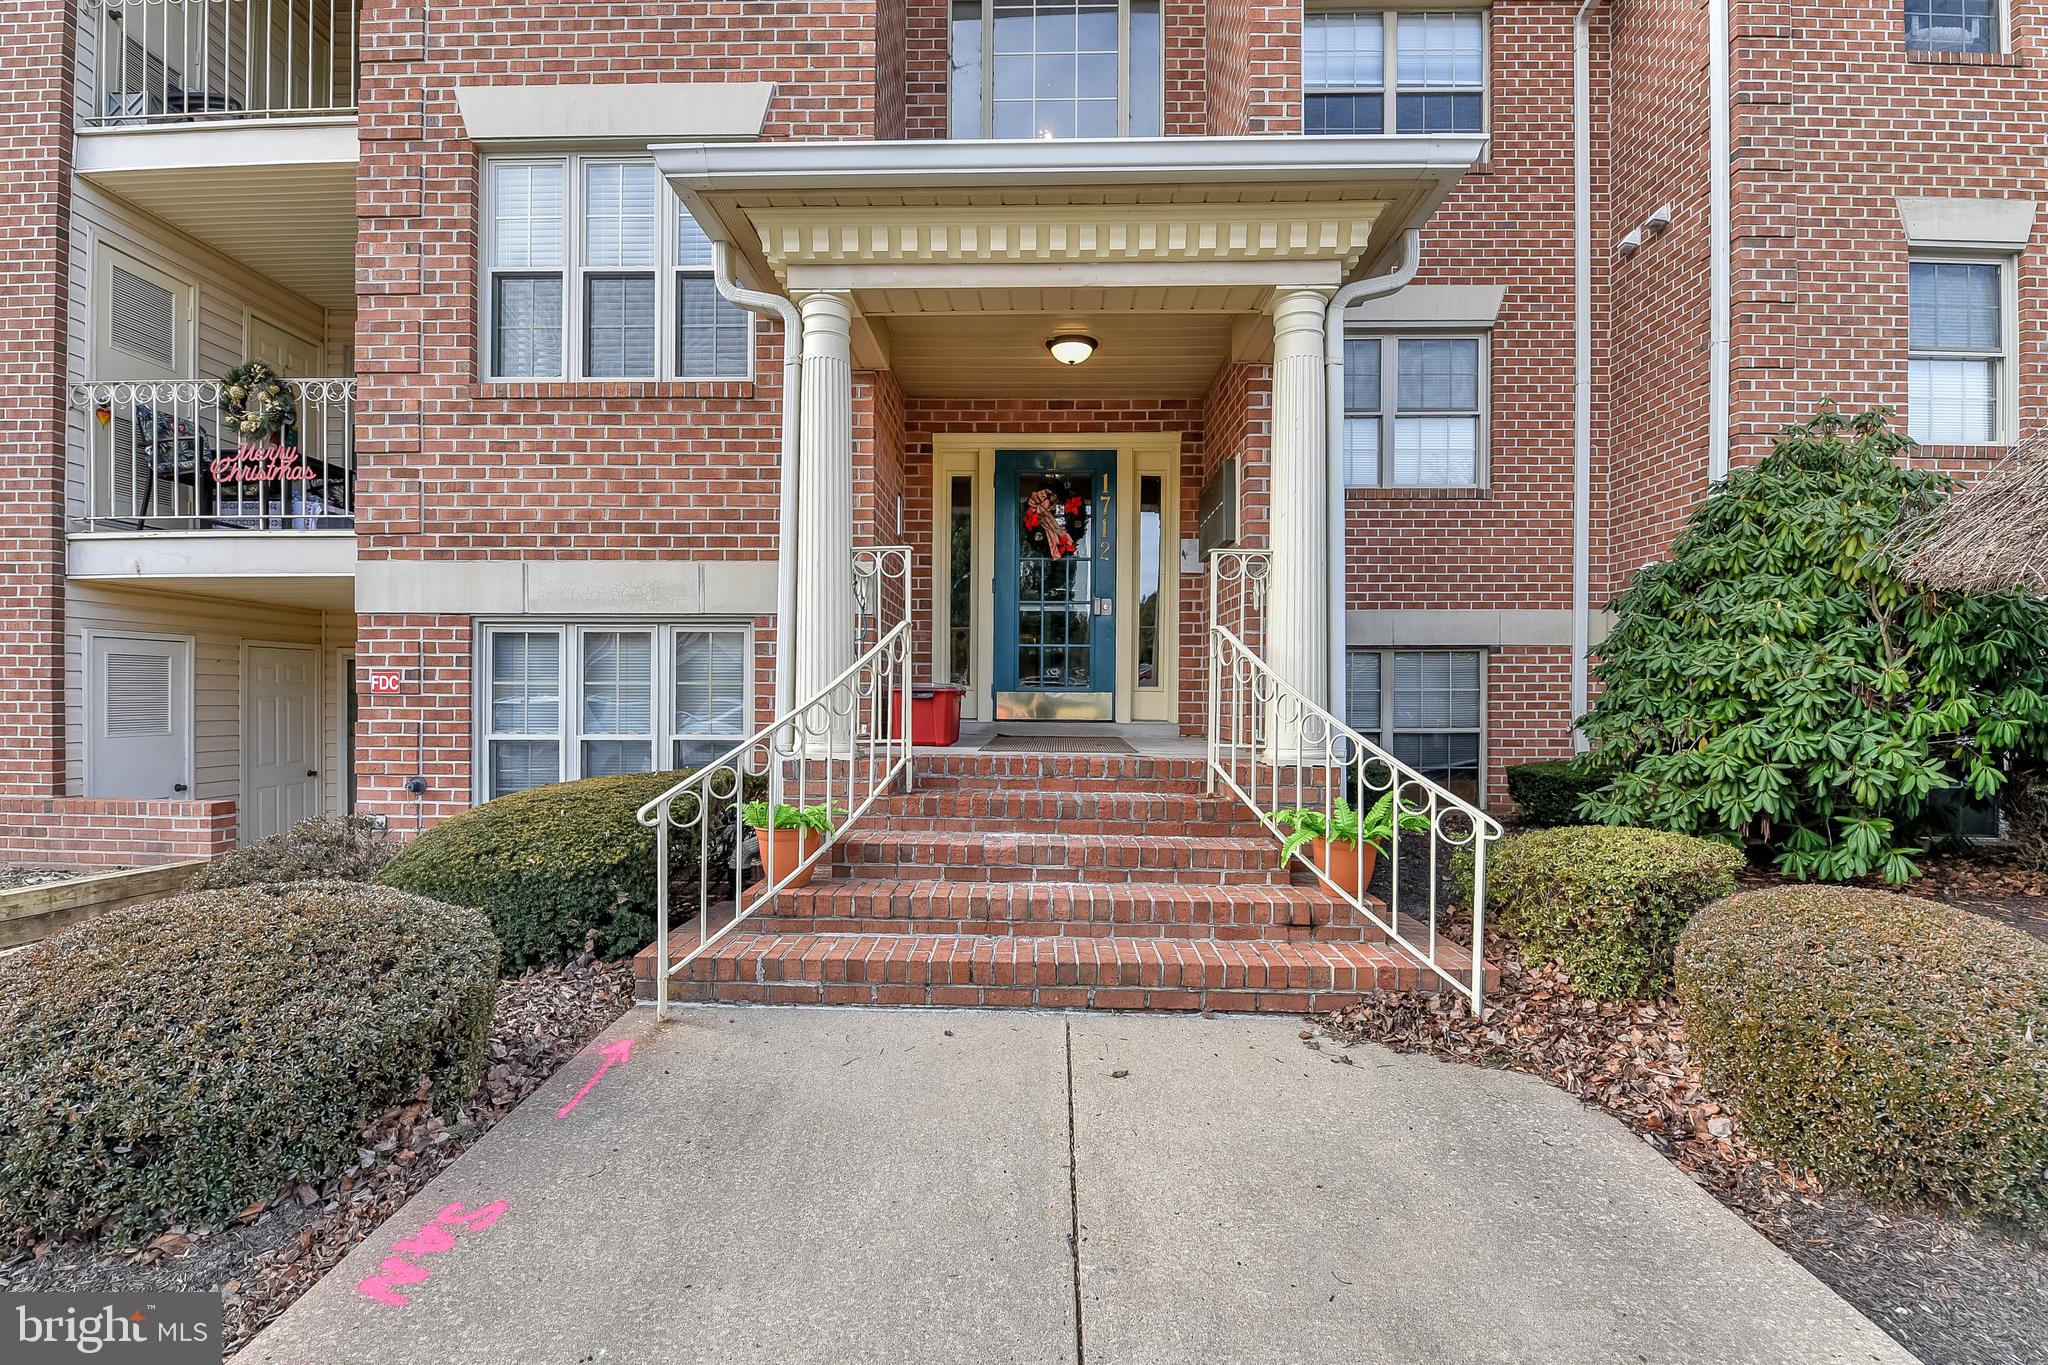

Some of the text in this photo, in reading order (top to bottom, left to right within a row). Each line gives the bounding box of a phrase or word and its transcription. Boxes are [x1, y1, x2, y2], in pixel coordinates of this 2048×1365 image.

[227, 441, 299, 466] Merry
[210, 458, 317, 482] Christmas
[1100, 473, 1111, 561] 1712
[371, 675, 399, 690] FDC
